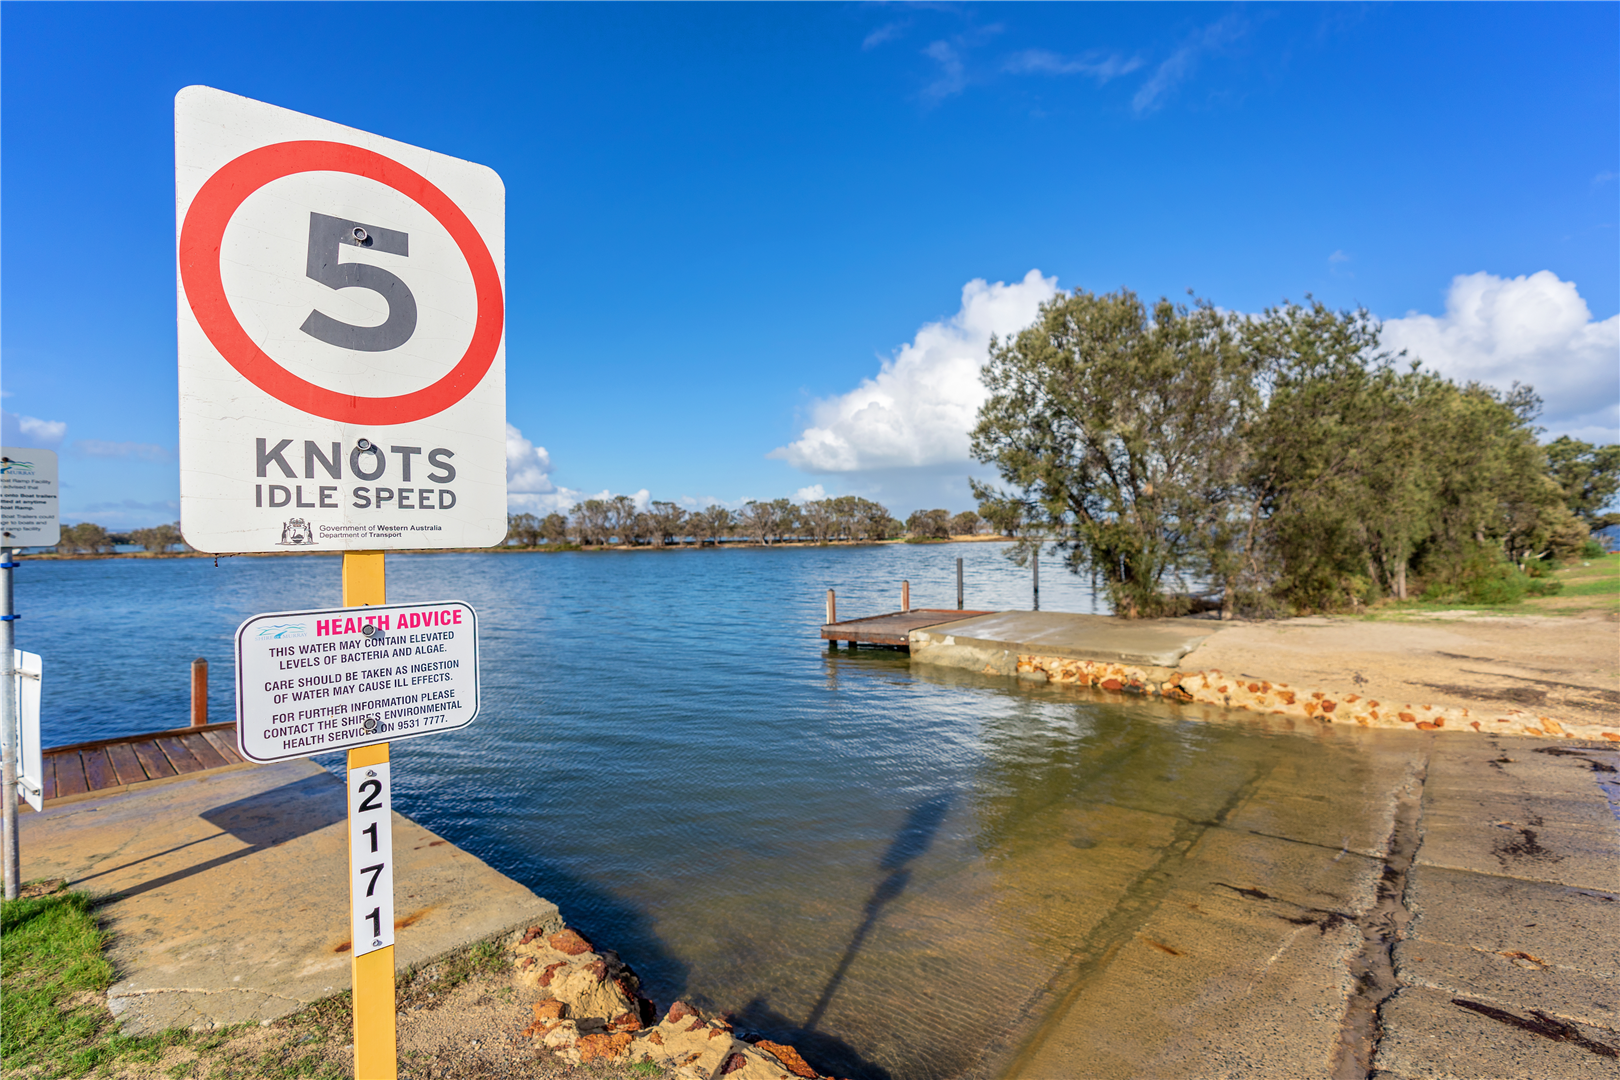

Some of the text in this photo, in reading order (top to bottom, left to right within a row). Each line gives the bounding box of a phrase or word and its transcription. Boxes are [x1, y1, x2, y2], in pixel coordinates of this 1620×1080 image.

[299, 211, 418, 352] 5
[256, 438, 456, 483] KNOTS
[255, 484, 457, 510] IDLE SPEED
[319, 524, 367, 532] Government
[368, 524, 376, 532] of
[282, 632, 308, 640] MURRAY
[316, 609, 462, 637] HEALTH ADVICE
[269, 630, 455, 658] THIS WATER MAY CONTAIN ELEVATED
[279, 643, 447, 670] LEVELS OF BACTERIA AND ALGAE.
[264, 659, 460, 692] CARE SHOULD BE TAKEN AS INGESTION
[273, 672, 453, 705] OF WATER MAY CAUSE ILL EFFECTS.
[263, 722, 315, 740] CONTACT
[317, 718, 338, 731] THE
[384, 700, 462, 720] ENVIRONMENTAL
[272, 689, 455, 725] FOR FURTHER INFORMATION PLEASE
[283, 714, 448, 750] HEALTH SERVICES ON 9531 7777.
